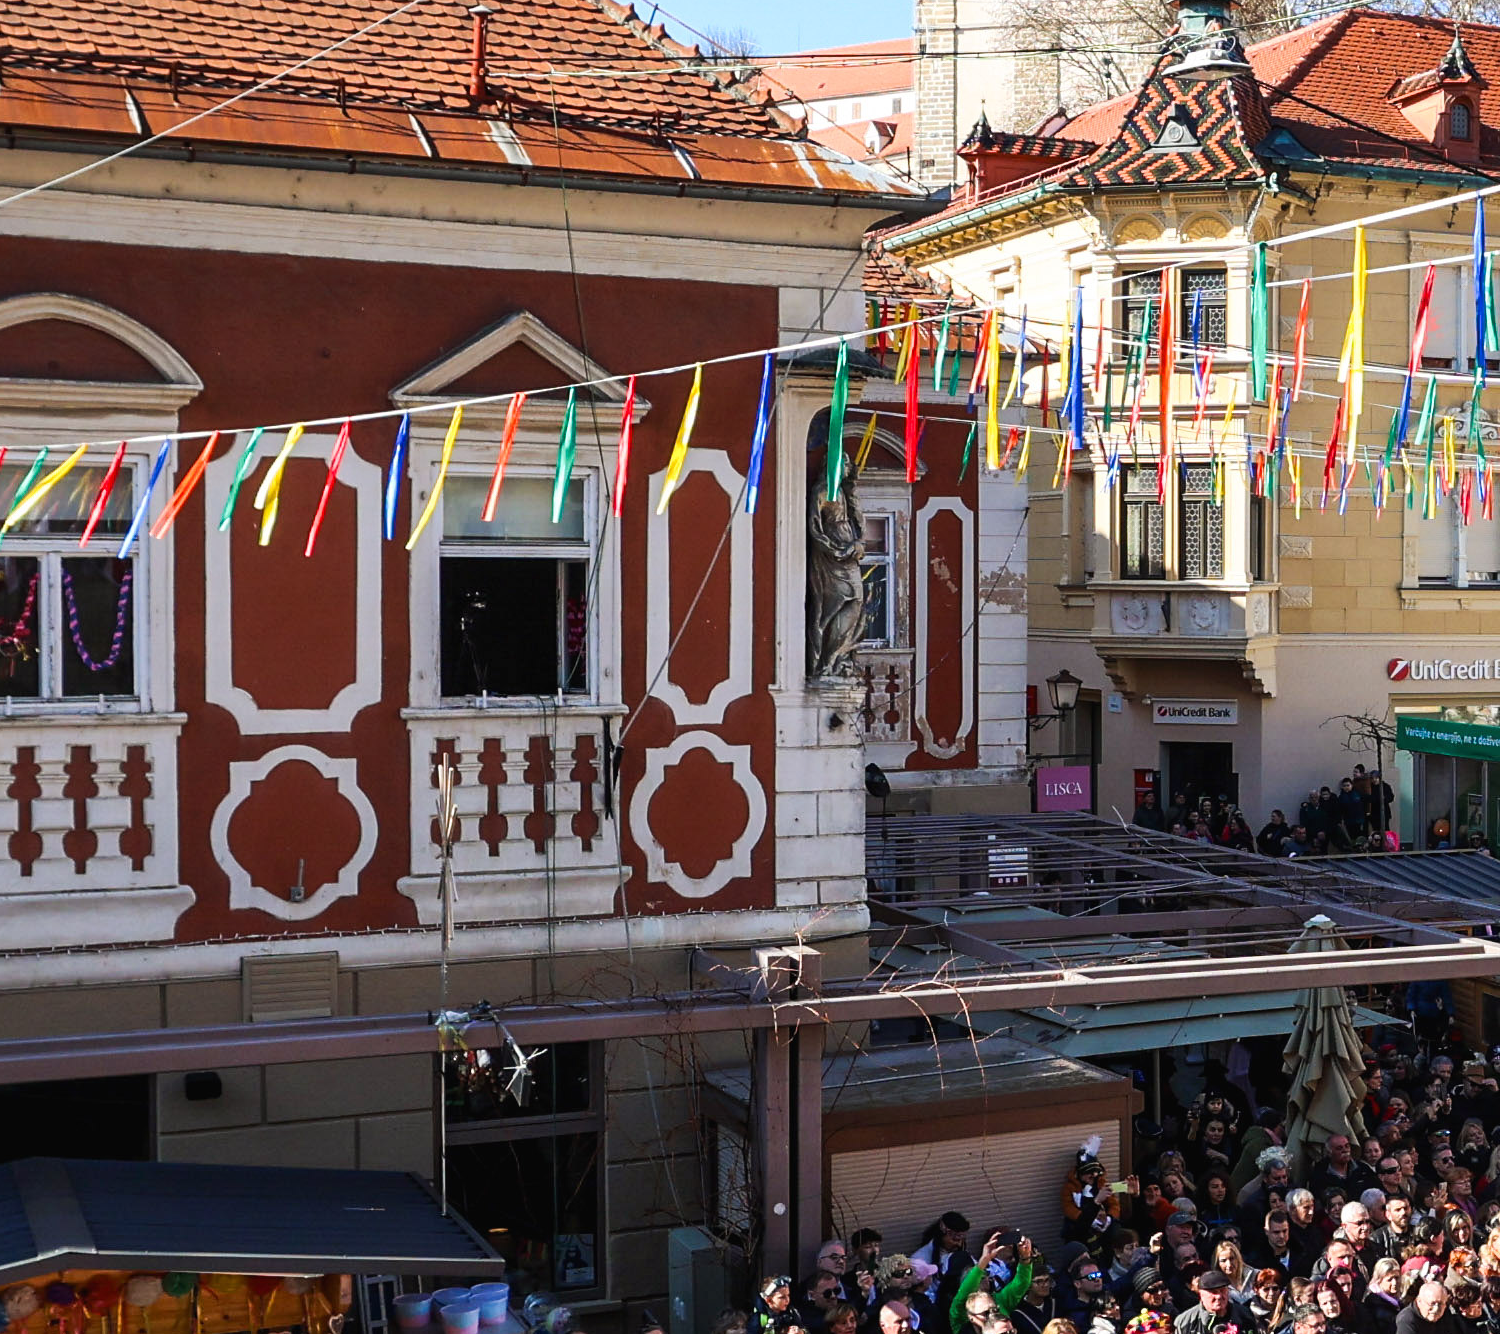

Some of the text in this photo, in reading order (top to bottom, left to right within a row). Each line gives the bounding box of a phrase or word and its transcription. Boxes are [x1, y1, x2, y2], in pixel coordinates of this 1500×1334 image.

[1410, 659, 1491, 681] UniCredit
[1168, 706, 1231, 718] UniCredit Bank
[1045, 782, 1083, 796] LISCA
